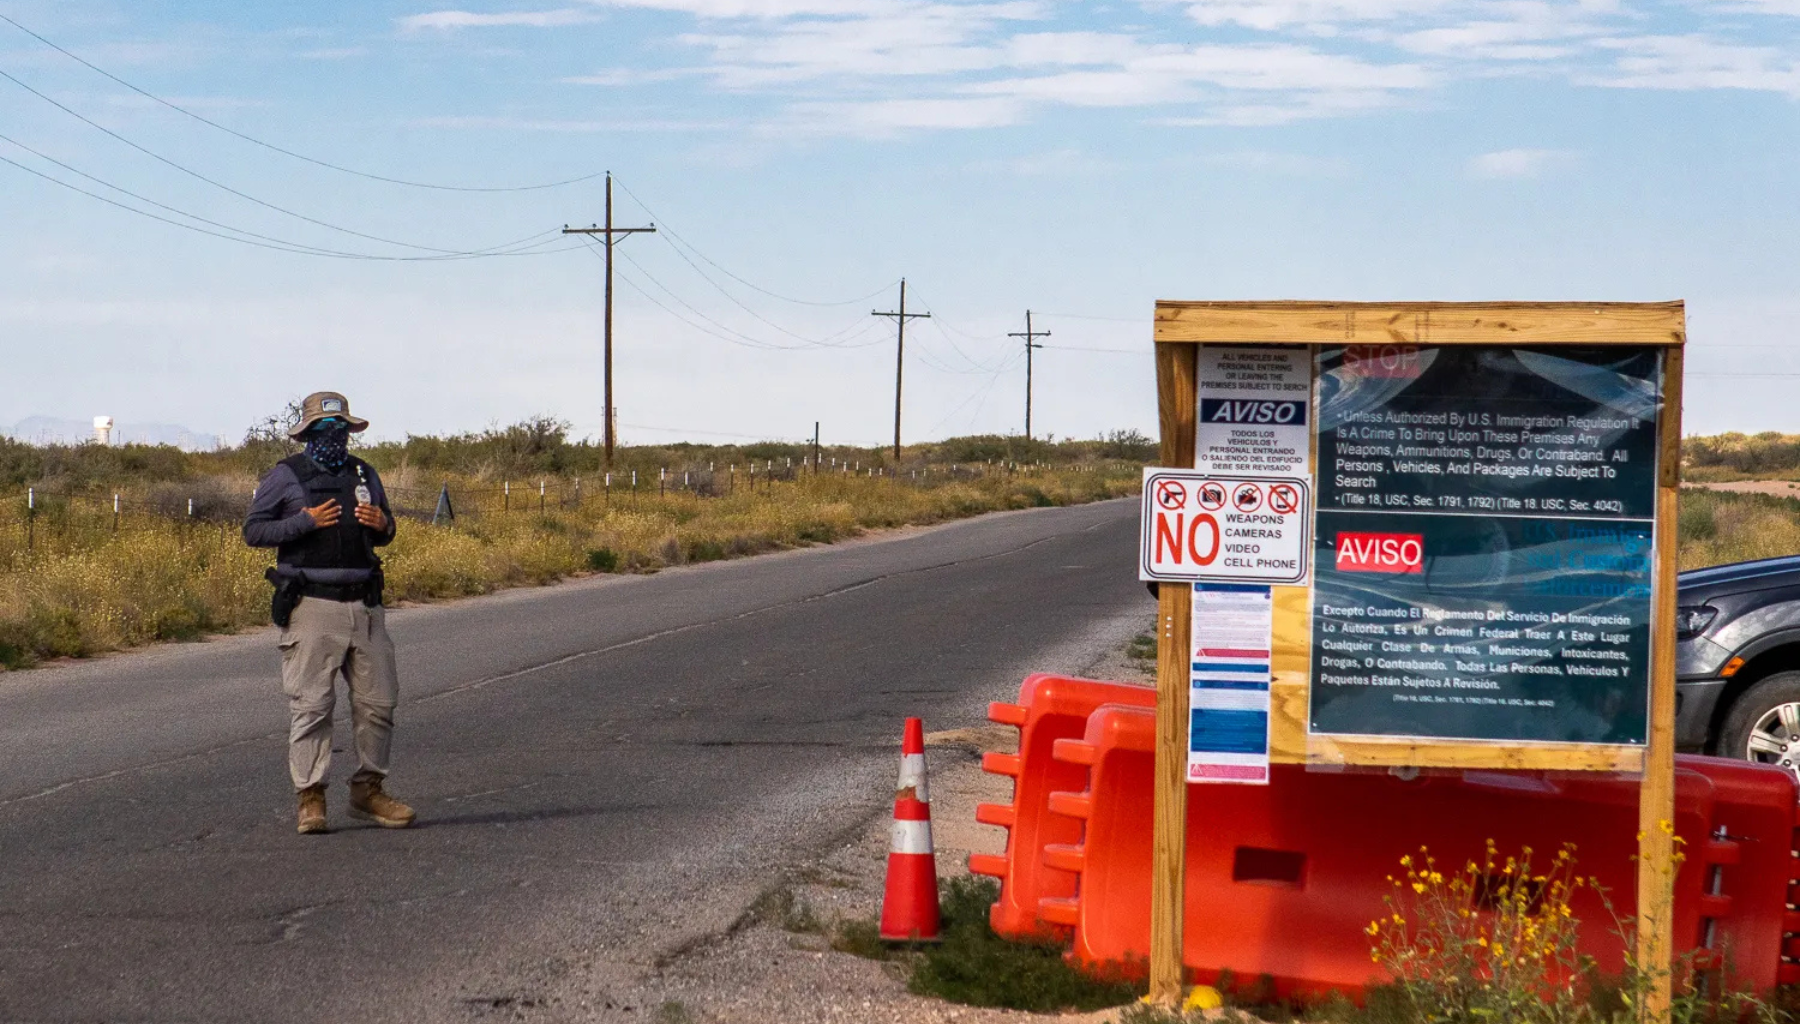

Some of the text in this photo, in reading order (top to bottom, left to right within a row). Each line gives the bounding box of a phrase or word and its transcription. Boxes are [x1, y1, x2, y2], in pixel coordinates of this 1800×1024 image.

[1344, 345, 1418, 370] STOP
[1257, 364, 1292, 372] ENTERING
[1201, 381, 1236, 389] PREMISES
[1239, 382, 1270, 390] SUBJECT
[1212, 401, 1296, 423] AVISO
[1344, 412, 1639, 430] Unless Authorized By U.S. Immigration Regulation It
[1337, 427, 1600, 447] Is A Crime To Bring Upon These Premises Any
[1210, 446, 1295, 455] PERSONAL ENTRANDO
[1336, 443, 1628, 462] Weapons, Ammunitions, Drugs, Or Contraband. All
[1393, 460, 1444, 475] Vehicles,
[1446, 462, 1470, 474] And
[1473, 462, 1530, 478] Packages
[1532, 464, 1552, 477] Are
[1555, 465, 1599, 480] Subject
[1602, 466, 1616, 478] To
[1336, 475, 1376, 488] Search
[1342, 493, 1366, 506] (Title
[1386, 494, 1411, 506] USC,
[1414, 496, 1434, 506] Sec.
[1468, 496, 1494, 508] 1792)
[1498, 498, 1522, 510] (Title
[1542, 499, 1567, 511] USC,
[1570, 500, 1591, 510] Sec.
[1594, 500, 1622, 513] 4042)
[1226, 514, 1284, 524] WEAPONS
[1155, 512, 1220, 566] NO
[1225, 528, 1282, 539] CAMERAS
[1225, 544, 1260, 554] VIDEO
[1336, 538, 1422, 566] AVISO
[1224, 559, 1296, 569] CELL PHONE
[1322, 604, 1364, 617] Excepto
[1367, 606, 1408, 618] Cuando
[1410, 608, 1420, 618] El
[1422, 608, 1484, 621] Reglamento
[1487, 610, 1505, 620] Del
[1507, 611, 1549, 622] Servicio
[1551, 612, 1567, 623] De
[1322, 623, 1335, 632] Lo
[1394, 625, 1407, 635] Es
[1414, 626, 1428, 636] Un
[1434, 626, 1472, 636] Crimen
[1480, 628, 1518, 638] Federal
[1524, 629, 1551, 640] Traer
[1556, 630, 1566, 640] A
[1572, 631, 1595, 642] Este
[1601, 632, 1630, 644] Lugar
[1322, 640, 1373, 652] Cualquier
[1382, 642, 1412, 652] Clase
[1420, 642, 1435, 653] De
[1562, 648, 1630, 660] Intoxicantes,
[1322, 657, 1361, 669] Drogas,
[1364, 658, 1374, 668] O
[1377, 658, 1447, 670] Contrabando.
[1456, 661, 1485, 672] Todas
[1490, 662, 1507, 672] Las
[1621, 667, 1630, 676] Y
[1320, 674, 1369, 687] Paquetes
[1372, 675, 1400, 686] Están
[1402, 676, 1441, 688] Sujetos
[1444, 678, 1450, 687] A
